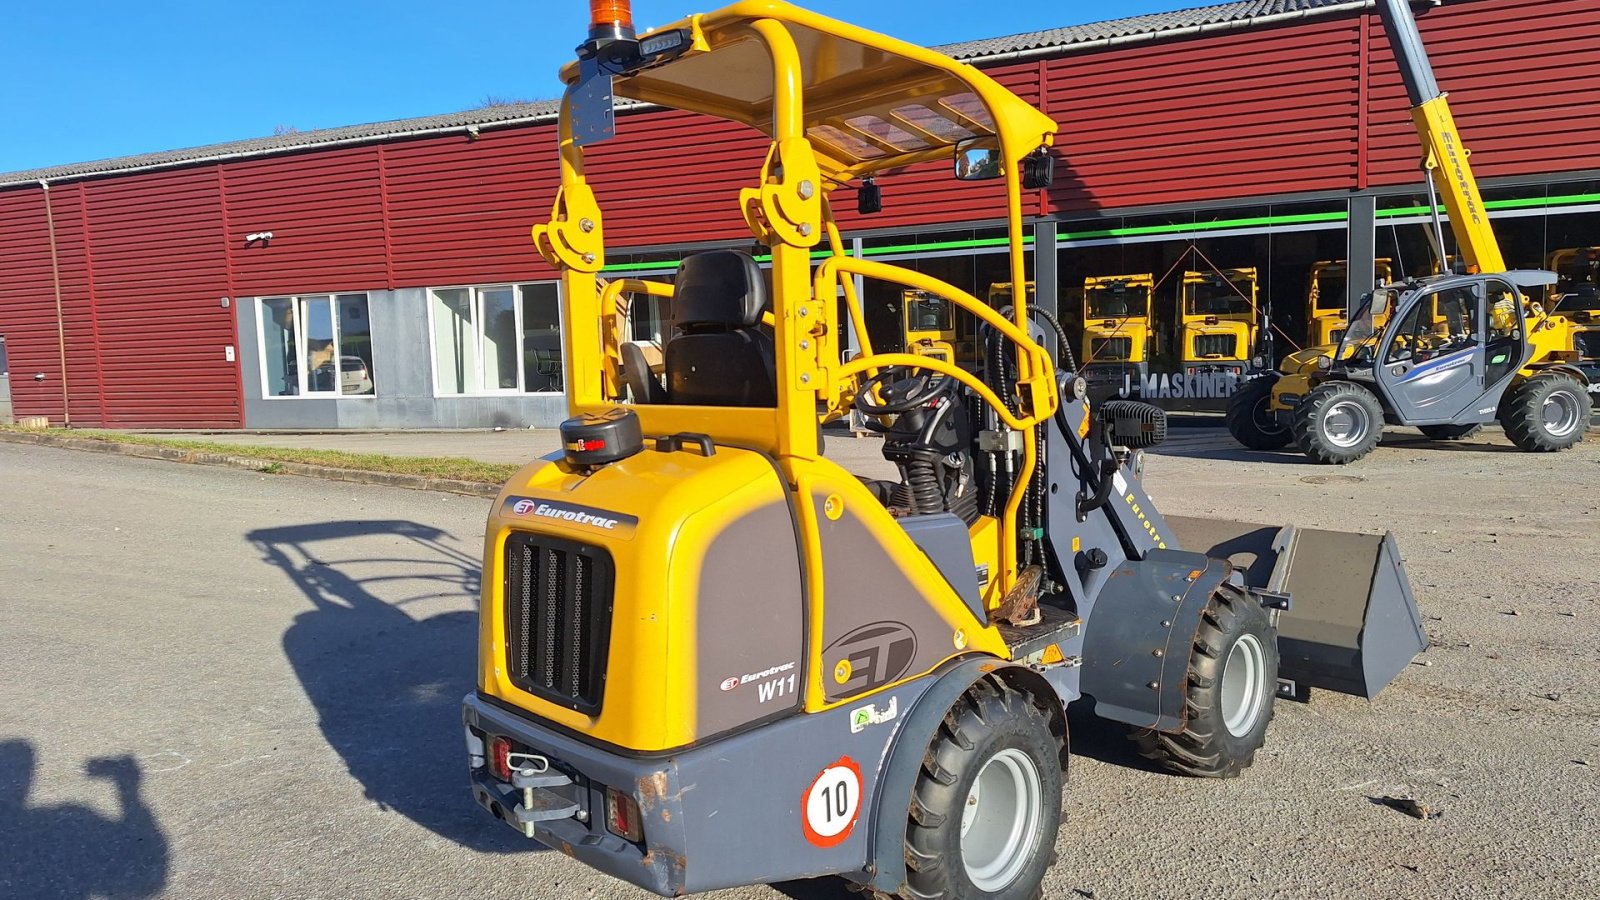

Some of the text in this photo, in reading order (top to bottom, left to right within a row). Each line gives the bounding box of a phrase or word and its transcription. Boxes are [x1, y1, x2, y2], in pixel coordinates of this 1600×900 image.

[534, 504, 618, 529] Eurotrac
[740, 661, 796, 685] Eurotrac
[758, 674, 796, 703] W11
[821, 780, 848, 823] 10
